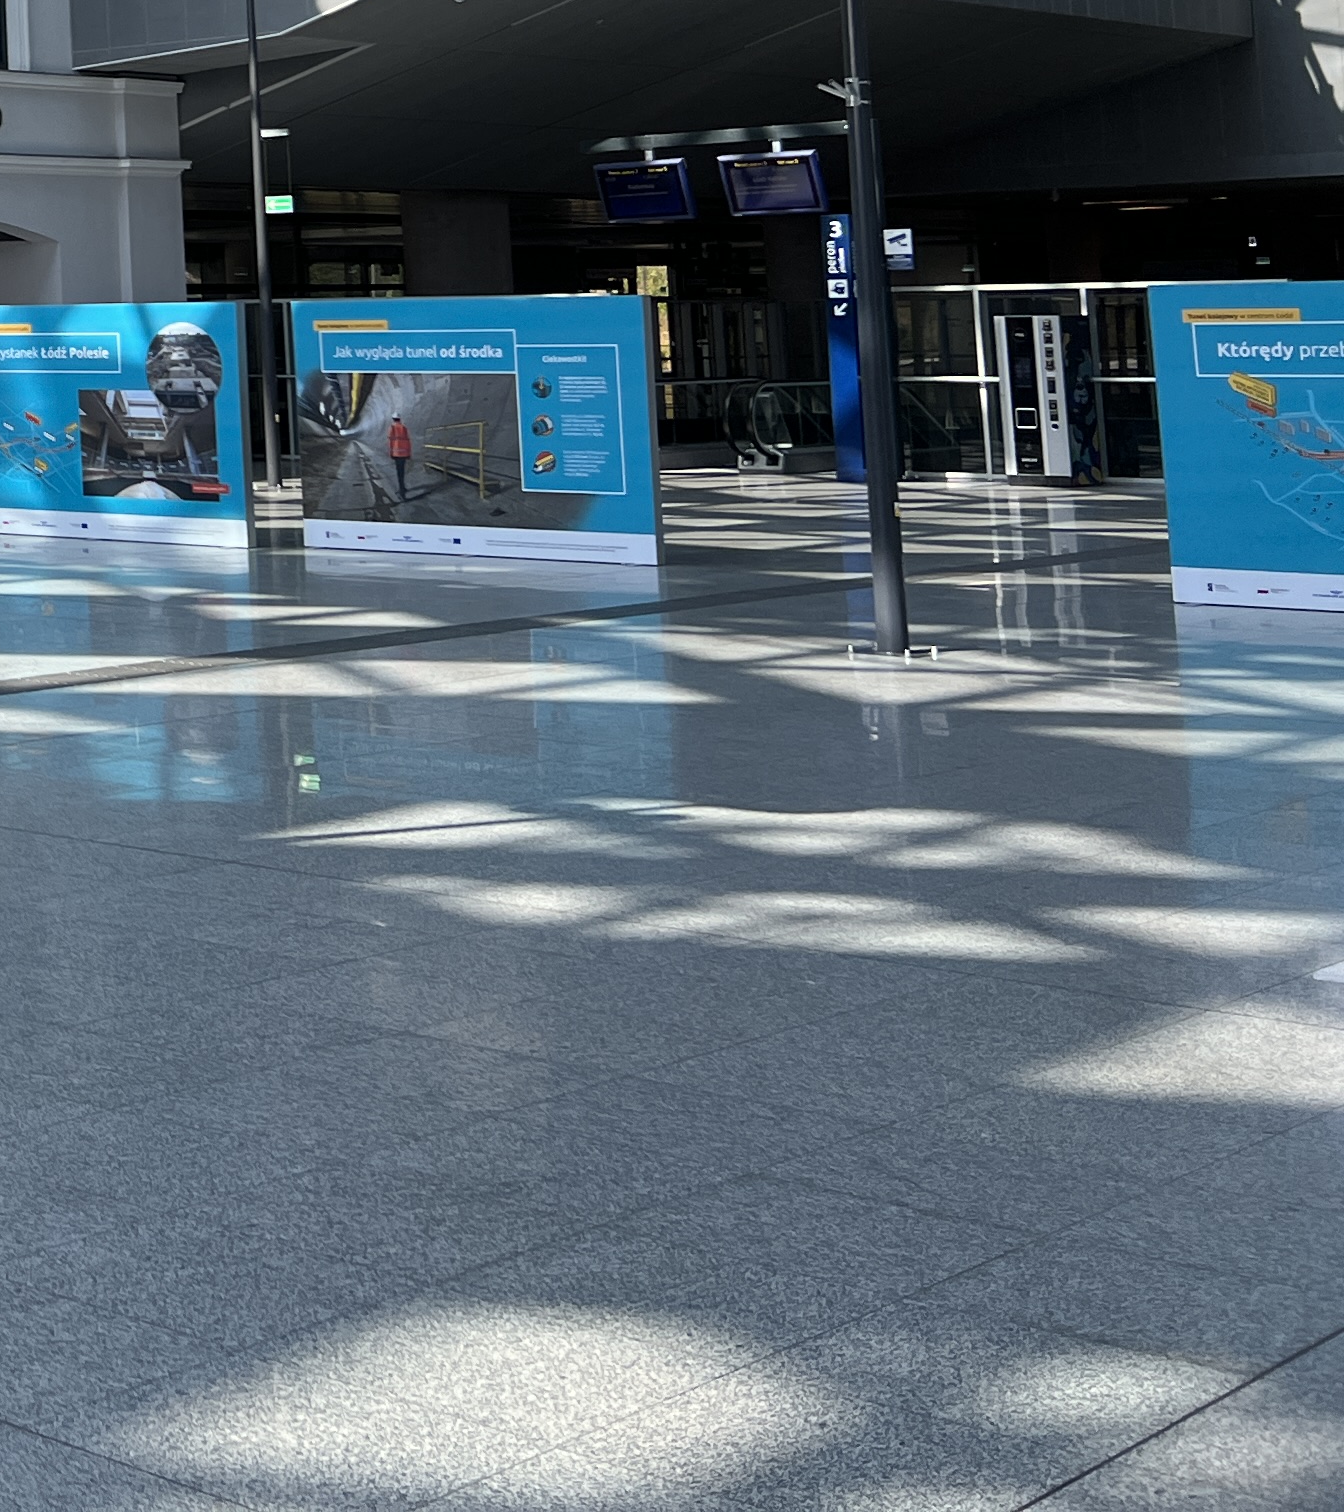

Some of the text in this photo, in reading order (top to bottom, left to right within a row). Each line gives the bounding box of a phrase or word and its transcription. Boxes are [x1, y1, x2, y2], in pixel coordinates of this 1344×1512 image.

[829, 220, 843, 238] 3
[826, 240, 839, 274] peron
[40, 345, 68, 359] Łódź
[69, 346, 109, 359] Polesie
[332, 344, 503, 360] Jak wygląda tunel od środka
[1217, 341, 1294, 362] Którędy
